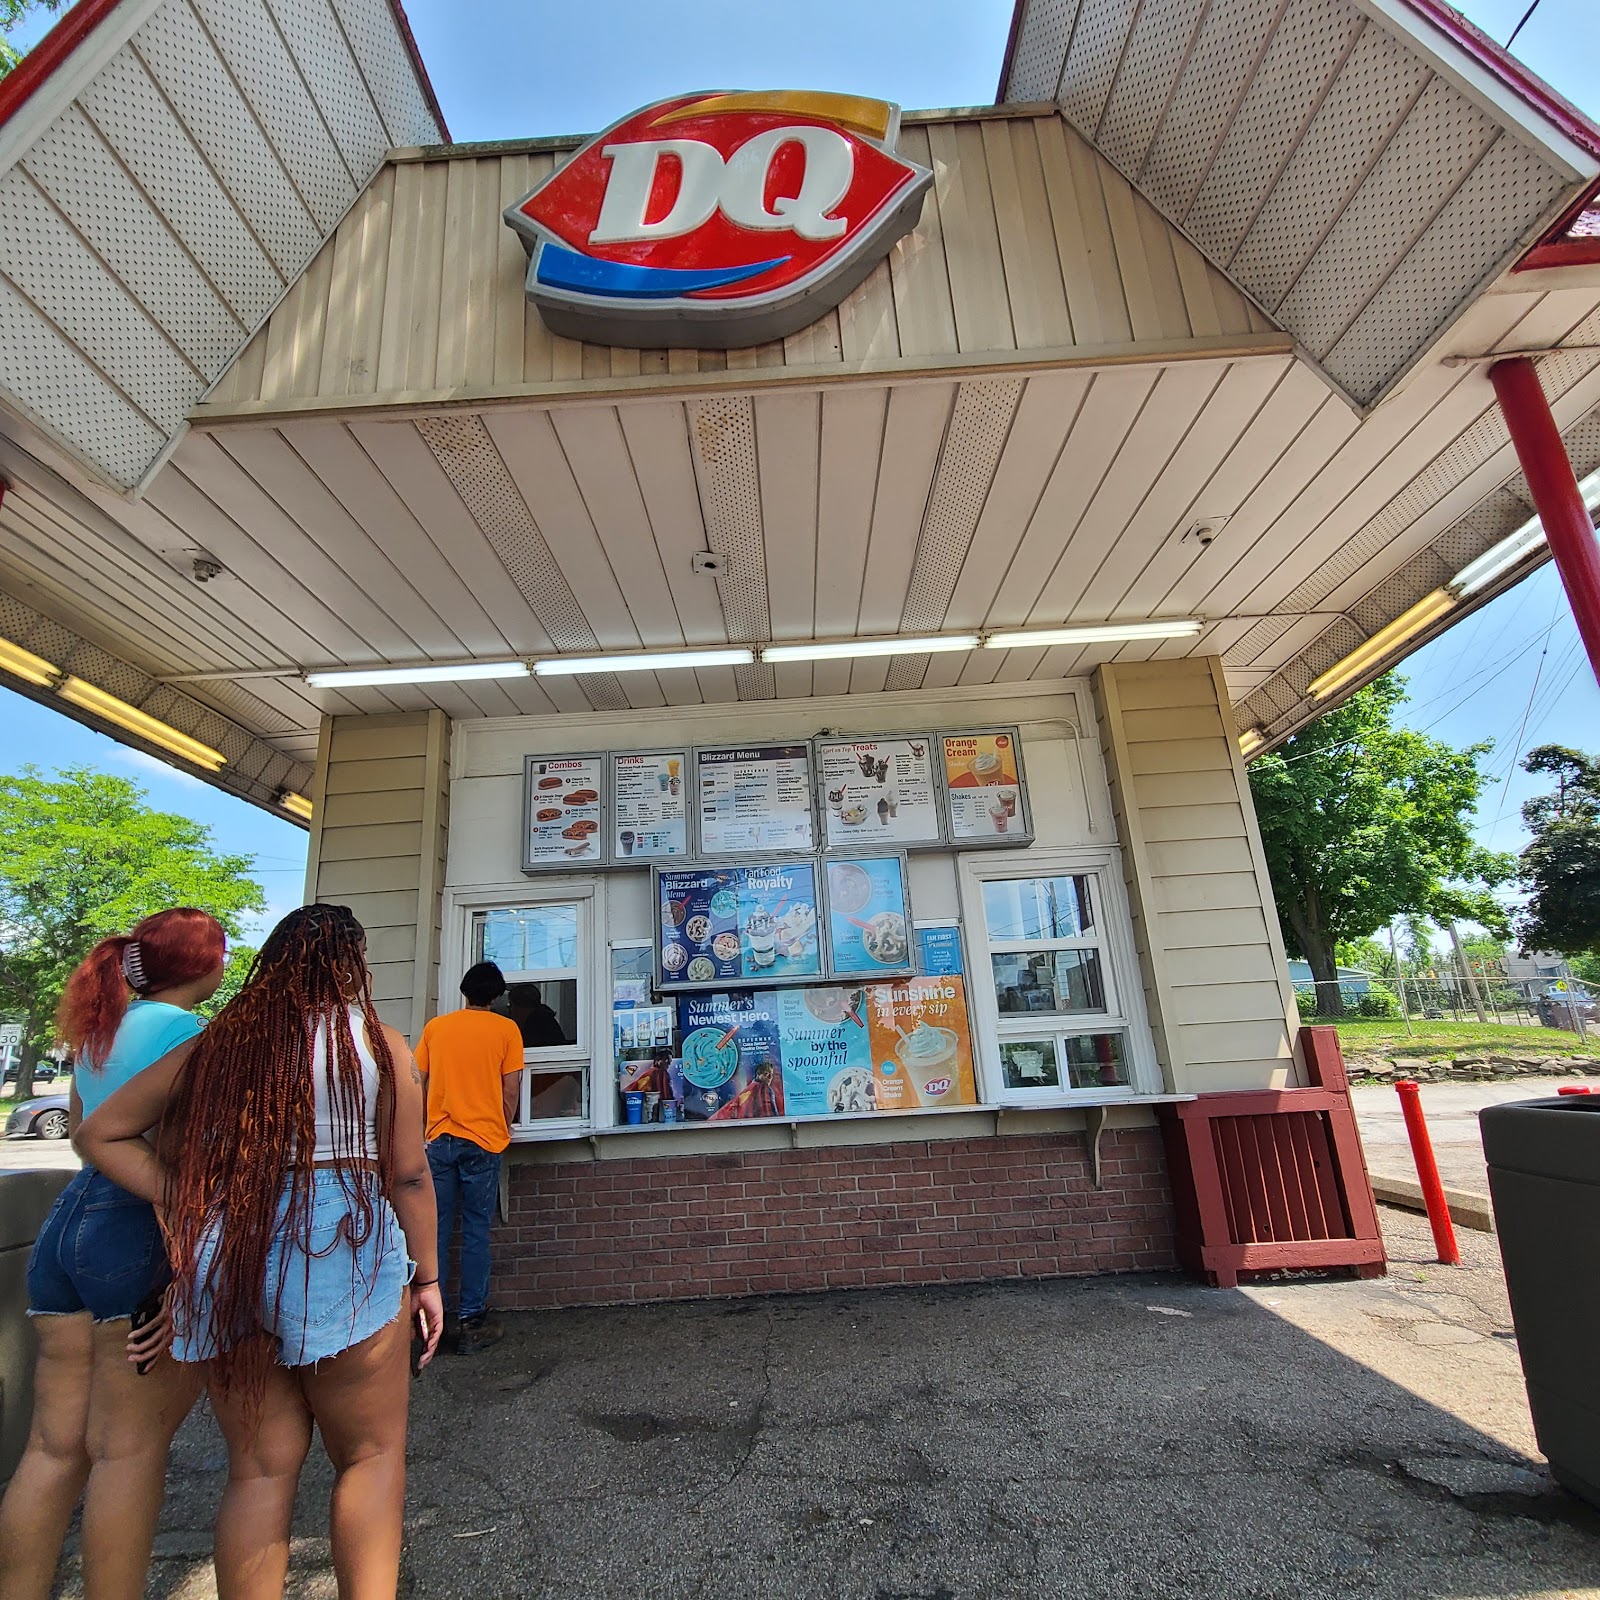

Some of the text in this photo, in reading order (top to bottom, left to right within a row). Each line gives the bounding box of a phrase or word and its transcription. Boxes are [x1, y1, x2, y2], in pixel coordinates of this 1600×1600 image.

[588, 126, 855, 245] DQ
[851, 743, 878, 751] Treats
[945, 738, 977, 748] Orange
[701, 751, 760, 761] Blizzard Menu
[946, 748, 976, 757] Cream
[548, 761, 582, 770] Combos
[665, 873, 695, 881] Summer
[745, 867, 781, 878] Fan Food
[665, 879, 708, 890] Blizzard
[748, 876, 793, 891] Royalty
[875, 986, 956, 1002] Sunshine
[688, 998, 753, 1014] Summer's
[876, 1002, 948, 1018] in every sip
[690, 1011, 770, 1026] Newest Hero
[1, 1036, 18, 1044] 30
[786, 1027, 846, 1042] Summer
[811, 1040, 847, 1054] by the
[788, 1051, 848, 1071] spoonful
[928, 1079, 952, 1093] DQ
